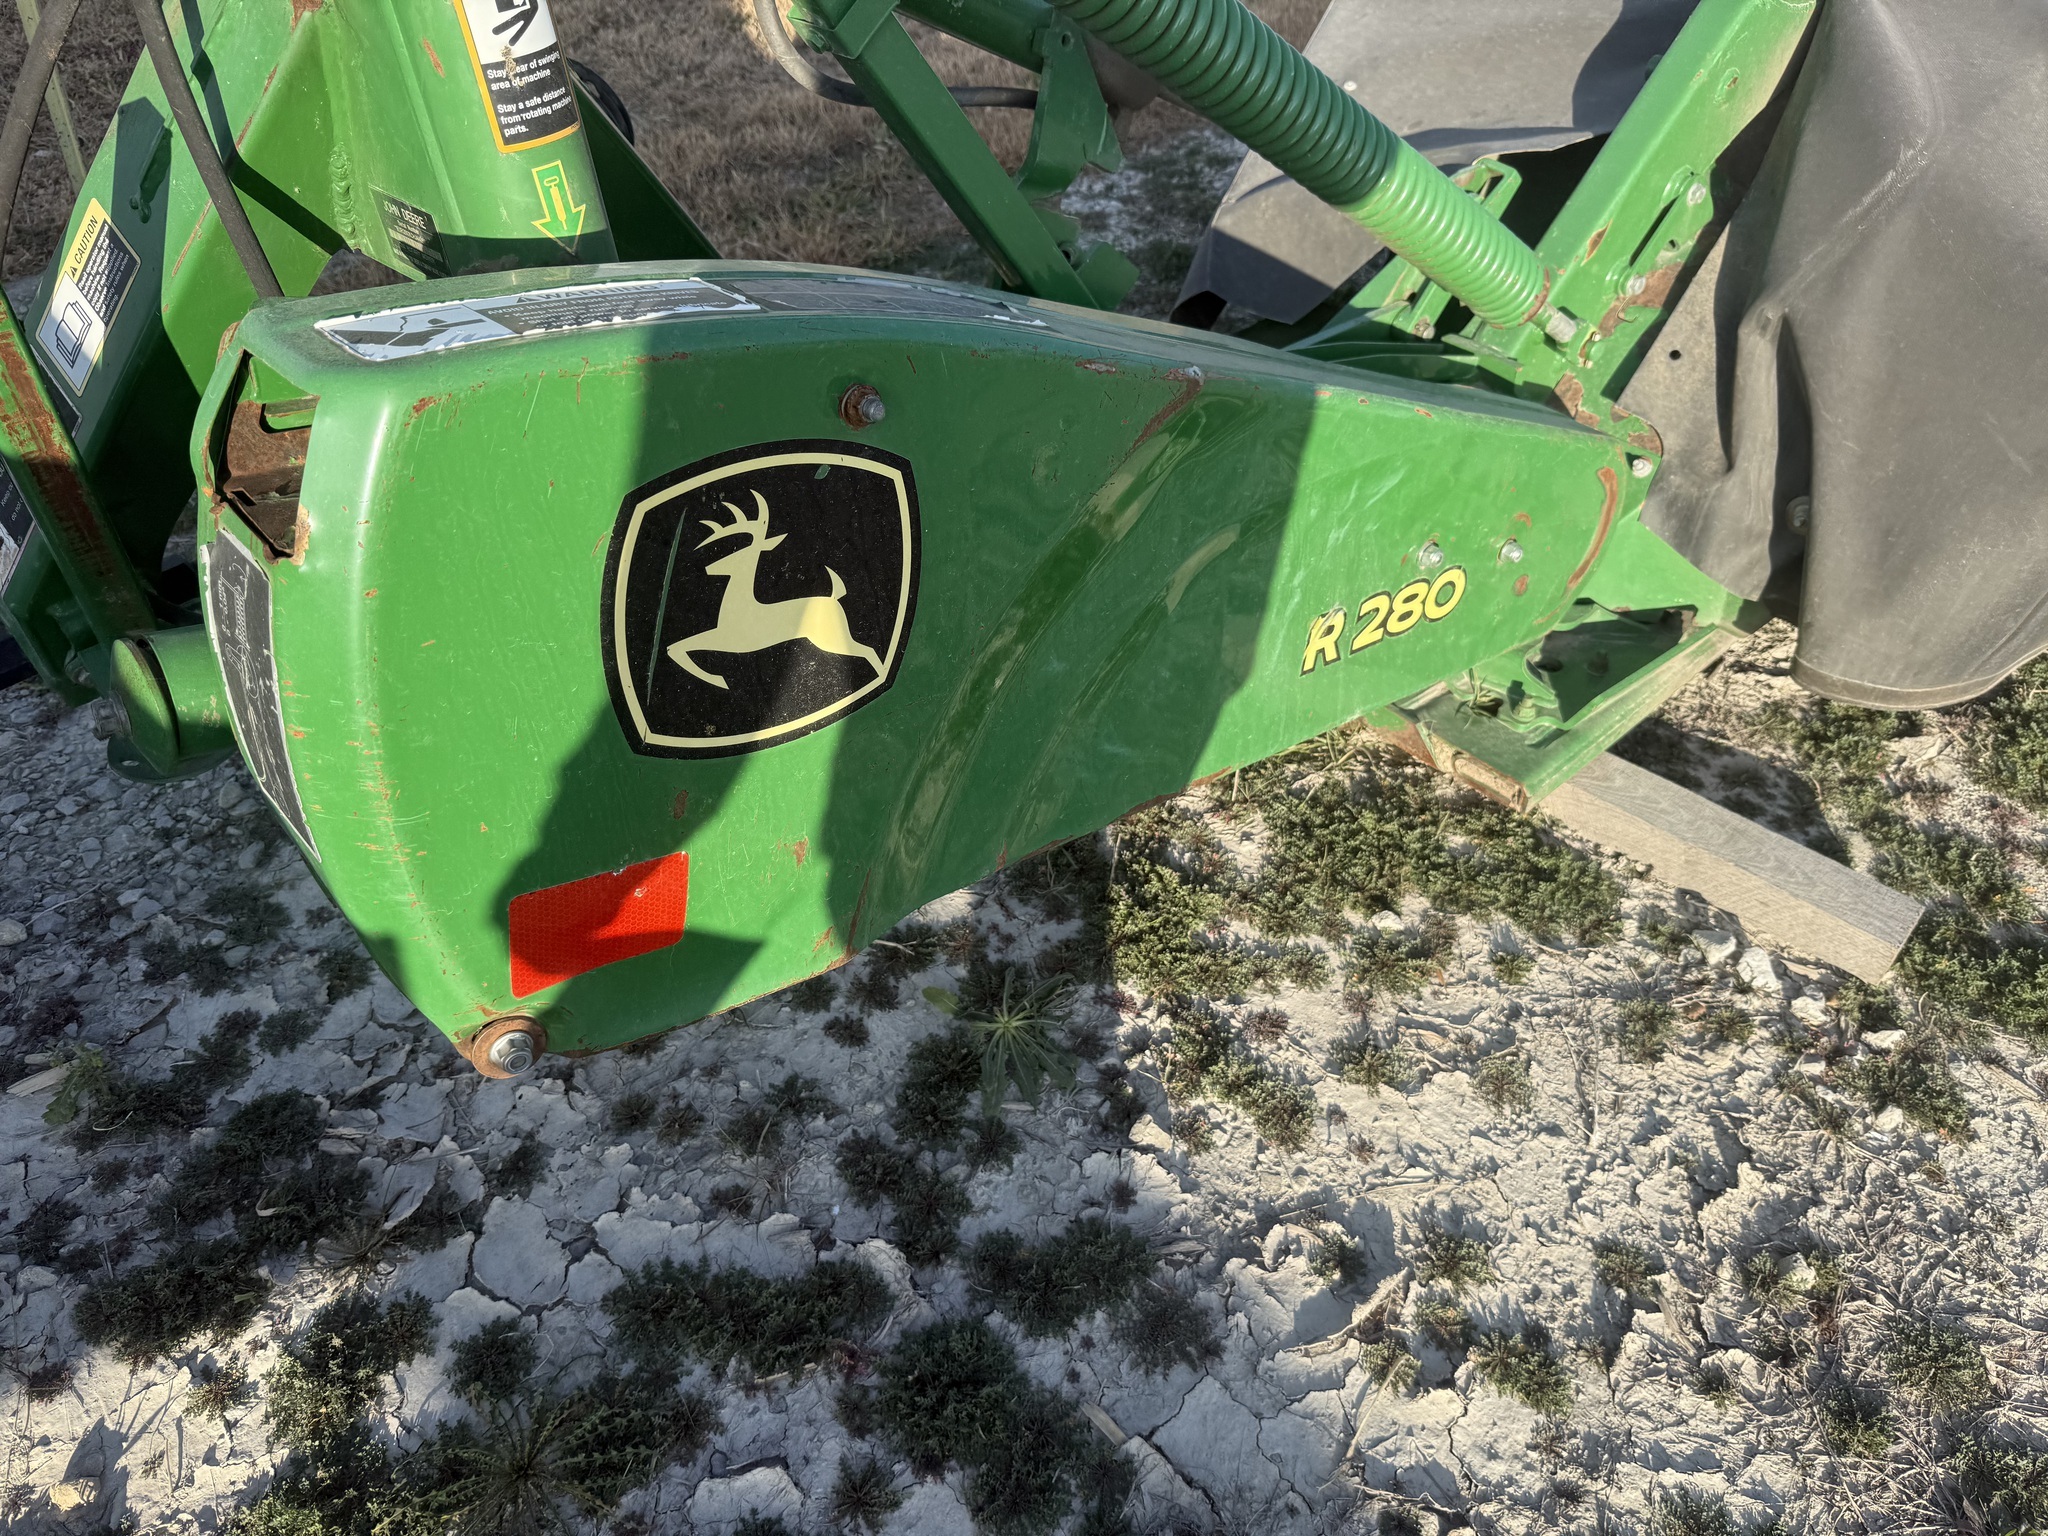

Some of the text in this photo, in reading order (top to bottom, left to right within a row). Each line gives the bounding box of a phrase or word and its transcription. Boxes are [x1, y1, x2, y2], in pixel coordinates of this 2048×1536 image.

[487, 69, 506, 79] Stay
[529, 59, 538, 69] of
[538, 50, 561, 66] swinging
[490, 80, 510, 91] area
[521, 68, 551, 84] machine
[497, 86, 566, 114] Stay a safe distance
[500, 95, 572, 125] from rotating machine
[503, 124, 529, 138] parts.
[382, 200, 427, 230] JOHN DEERE
[74, 215, 98, 264] CAUTION
[78, 223, 109, 290] Read operator manual
[82, 236, 110, 296] before handling the
[104, 288, 115, 306] safety
[113, 271, 122, 288] rules
[121, 254, 130, 271] when
[537, 284, 660, 300] WARNING
[91, 290, 101, 307] copy
[94, 286, 107, 312] Observe
[487, 305, 524, 315] AVOID
[525, 301, 567, 310] INJURY
[513, 308, 546, 317] Keep
[548, 305, 586, 313] hands
[1299, 565, 1468, 677] R 280
